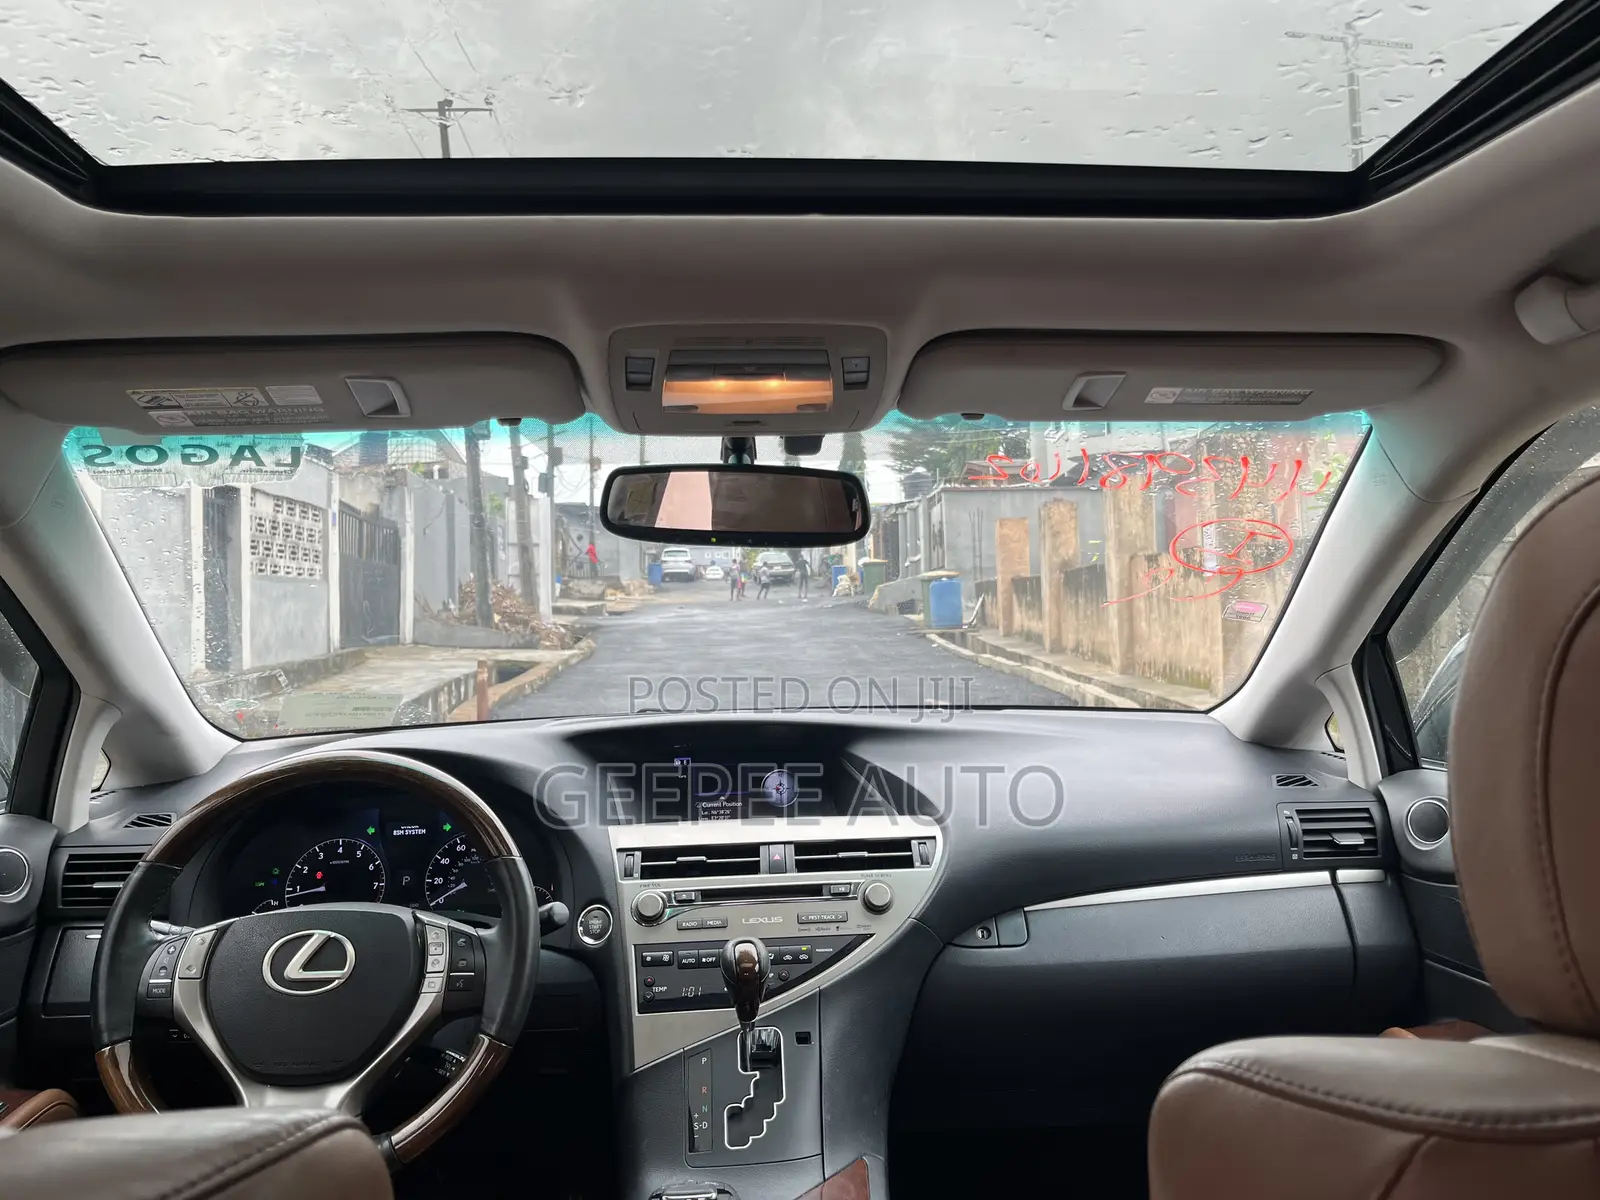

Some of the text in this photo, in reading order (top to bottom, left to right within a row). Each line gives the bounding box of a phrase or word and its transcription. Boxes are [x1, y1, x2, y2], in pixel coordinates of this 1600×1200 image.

[404, 828, 427, 836] SYSTEM
[456, 844, 466, 852] 60
[319, 852, 324, 860] 3
[440, 857, 450, 865] 40
[302, 866, 309, 874] 2
[402, 876, 411, 886] P
[433, 877, 444, 885] 20
[373, 882, 379, 890] 7
[742, 916, 784, 925] LEXUS
[681, 986, 702, 997] 1:01
[701, 1057, 707, 1065] P
[701, 1086, 708, 1094] R
[702, 1105, 708, 1113] N
